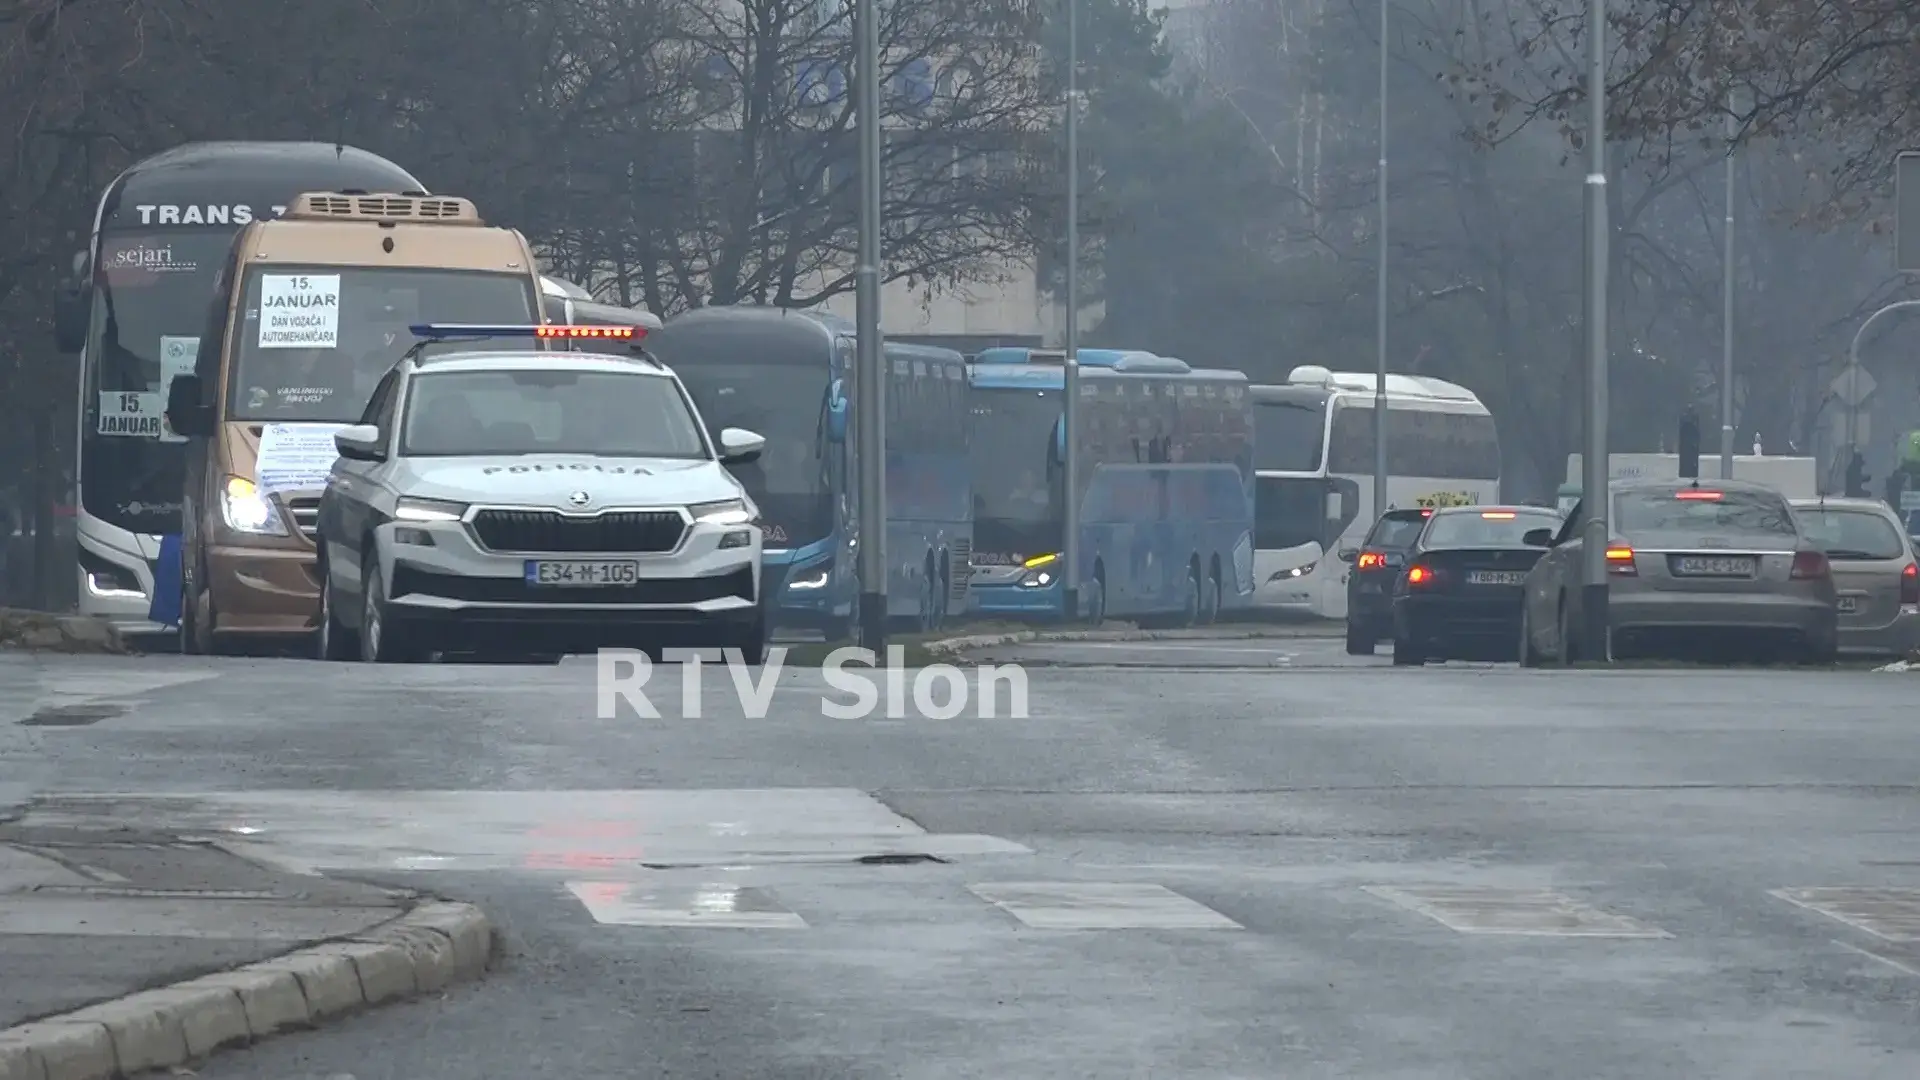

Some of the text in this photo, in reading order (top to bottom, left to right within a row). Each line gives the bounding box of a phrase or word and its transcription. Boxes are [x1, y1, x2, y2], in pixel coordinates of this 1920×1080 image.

[136, 205, 252, 224] TRANS
[290, 277, 312, 289] 15.
[264, 294, 336, 308] JANUAR
[272, 316, 288, 326] DAN
[119, 393, 143, 412] 15.
[101, 415, 159, 433] JANUAR
[483, 463, 655, 476] POLICIJA
[538, 563, 634, 582] E34-M-105
